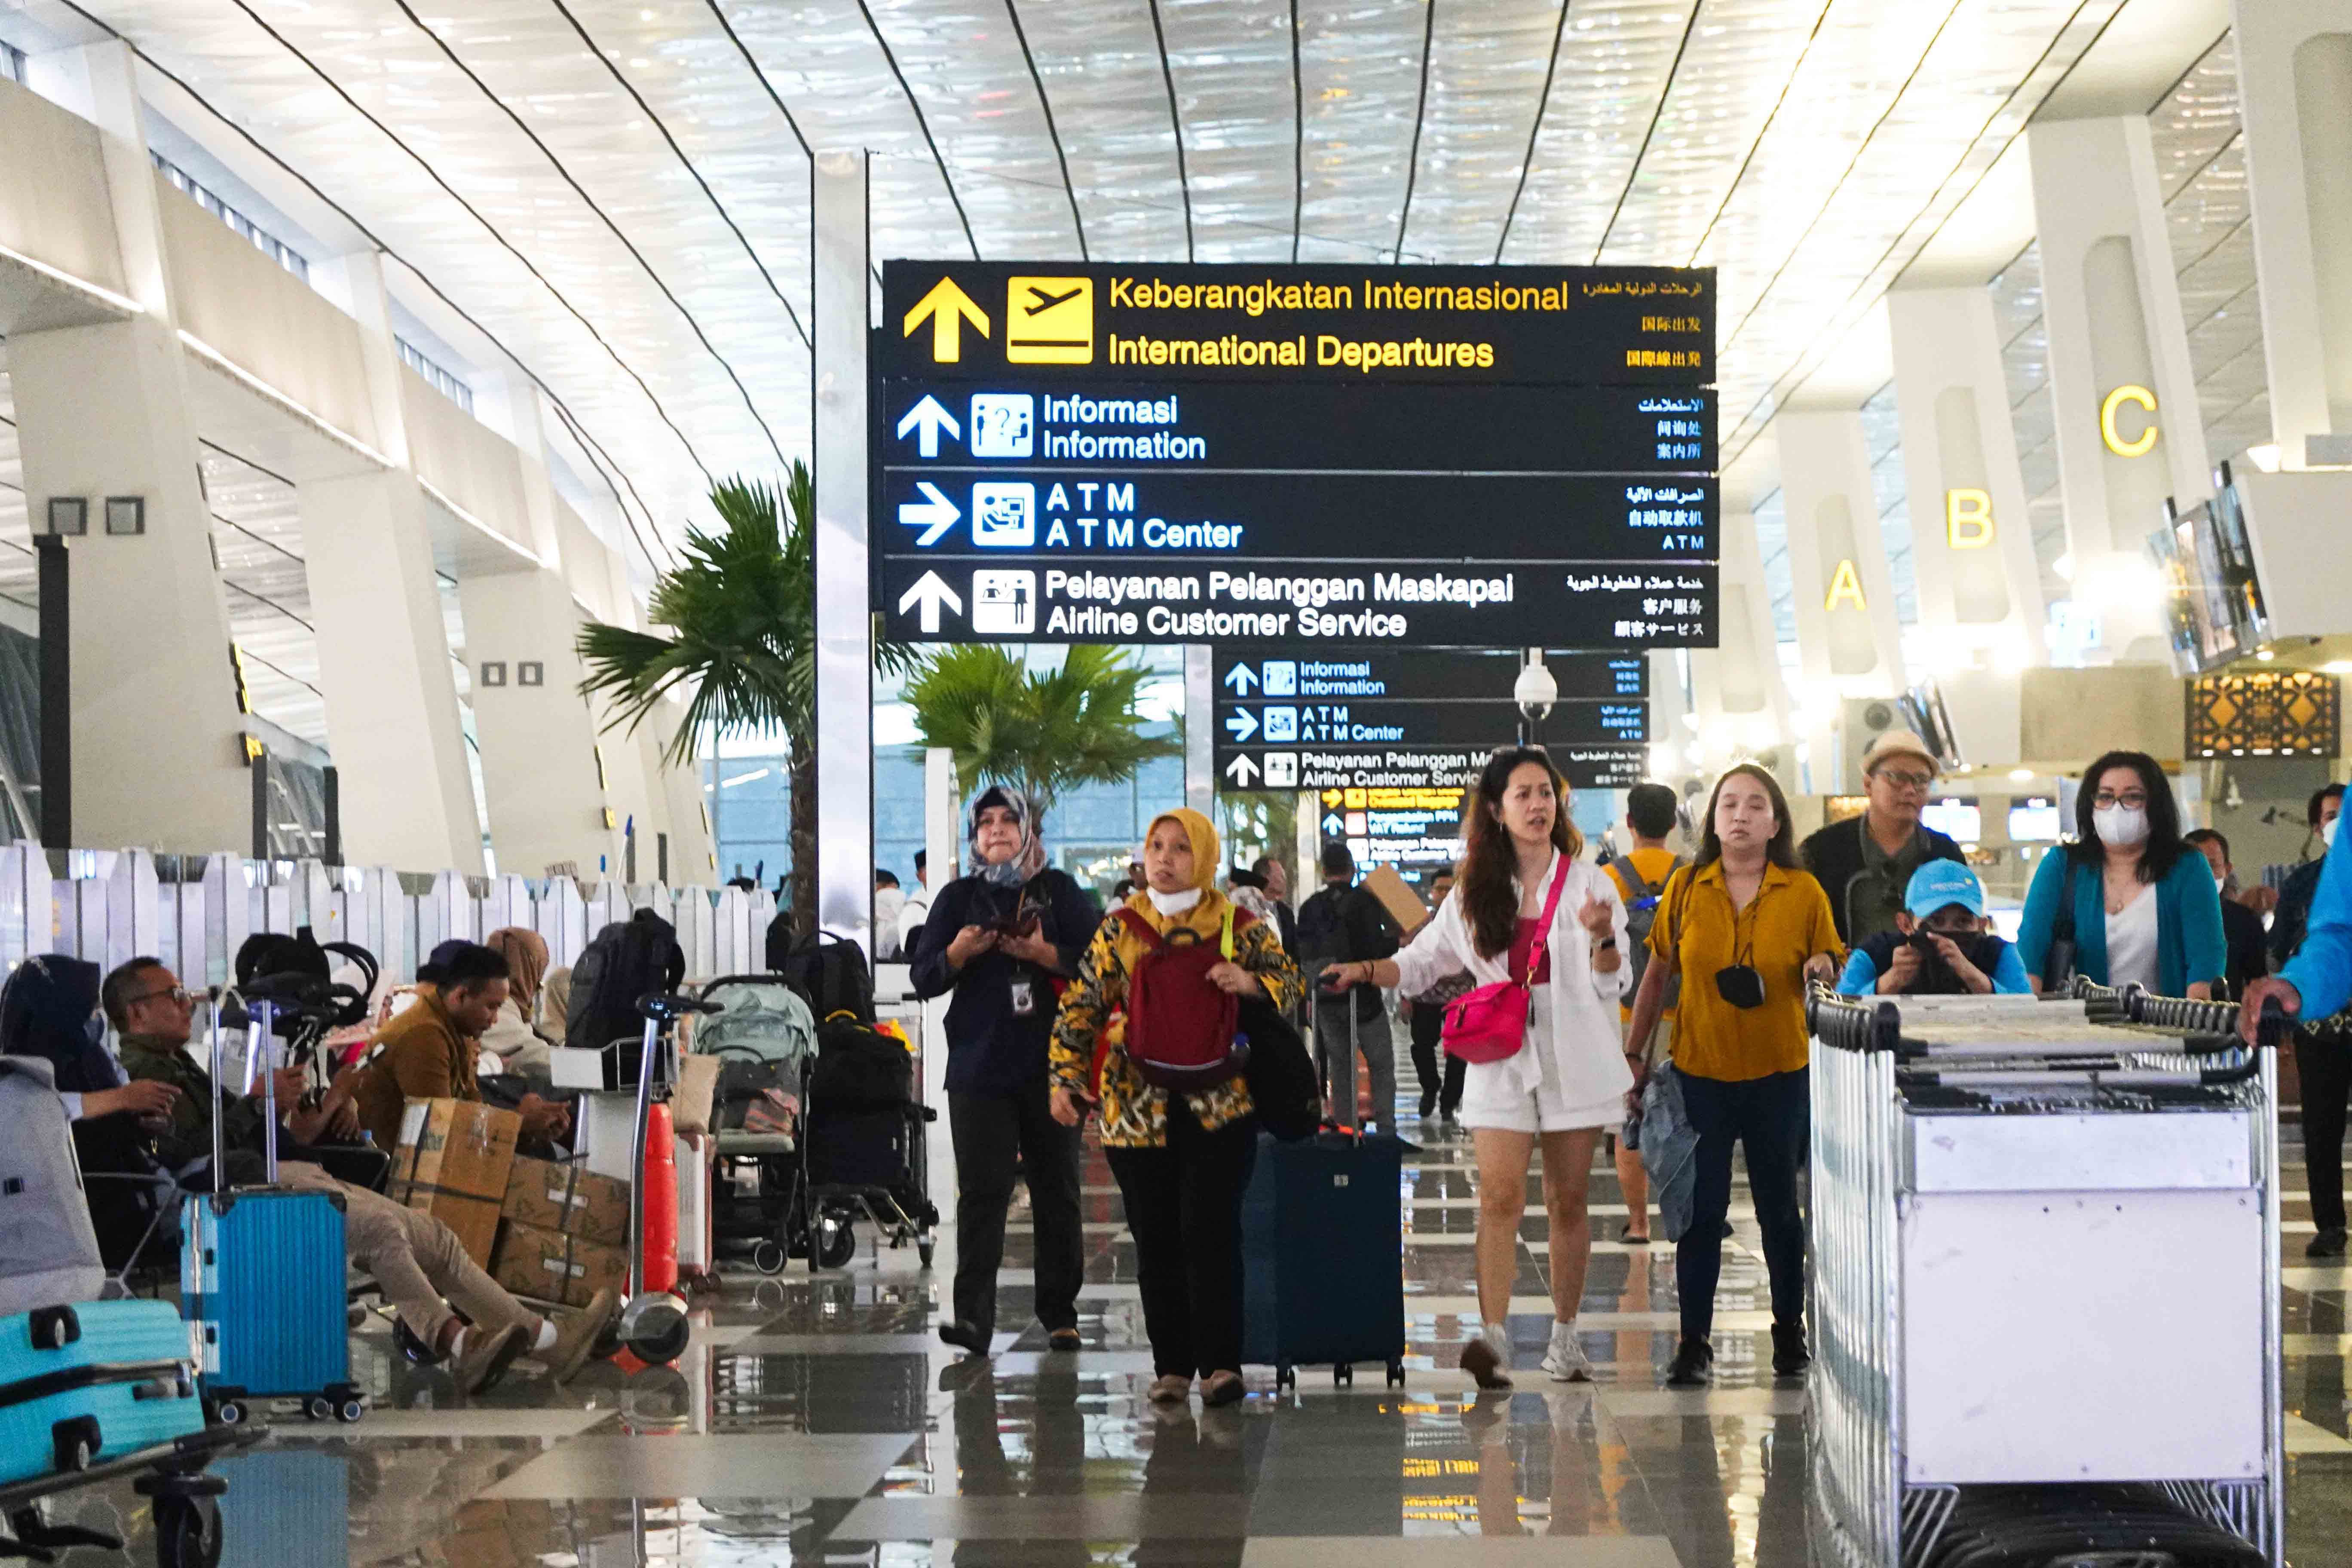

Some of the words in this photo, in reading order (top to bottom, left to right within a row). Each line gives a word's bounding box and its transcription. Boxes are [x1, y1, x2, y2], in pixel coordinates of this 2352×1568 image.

[1110, 277, 1352, 316] Keberangkatan
[1365, 279, 1568, 310] Internasional
[1109, 334, 1306, 366] International
[1317, 335, 1494, 374] Departures
[1044, 394, 1177, 424] Informasi
[2101, 385, 2158, 457] C
[1044, 431, 1206, 459] Information
[1143, 518, 1243, 548] Center
[1947, 488, 1995, 549] B
[1046, 570, 1200, 605] Pelayanan
[1209, 571, 1364, 607] Pelanggan
[1375, 573, 1514, 608] Maskapai
[1825, 559, 1866, 610] A
[1047, 606, 1138, 634] Airline
[1146, 606, 1290, 636] Customer
[1298, 608, 1407, 637] Service
[1300, 661, 1370, 678] Informasi
[1300, 679, 1385, 695] Information
[1352, 725, 1404, 741] Center
[1302, 752, 1382, 771] Pelayanan
[1385, 752, 1467, 771] Pelanggan
[1302, 770, 1350, 787] Airline
[1354, 770, 1427, 787] Customer
[1432, 770, 1481, 787] Servic
